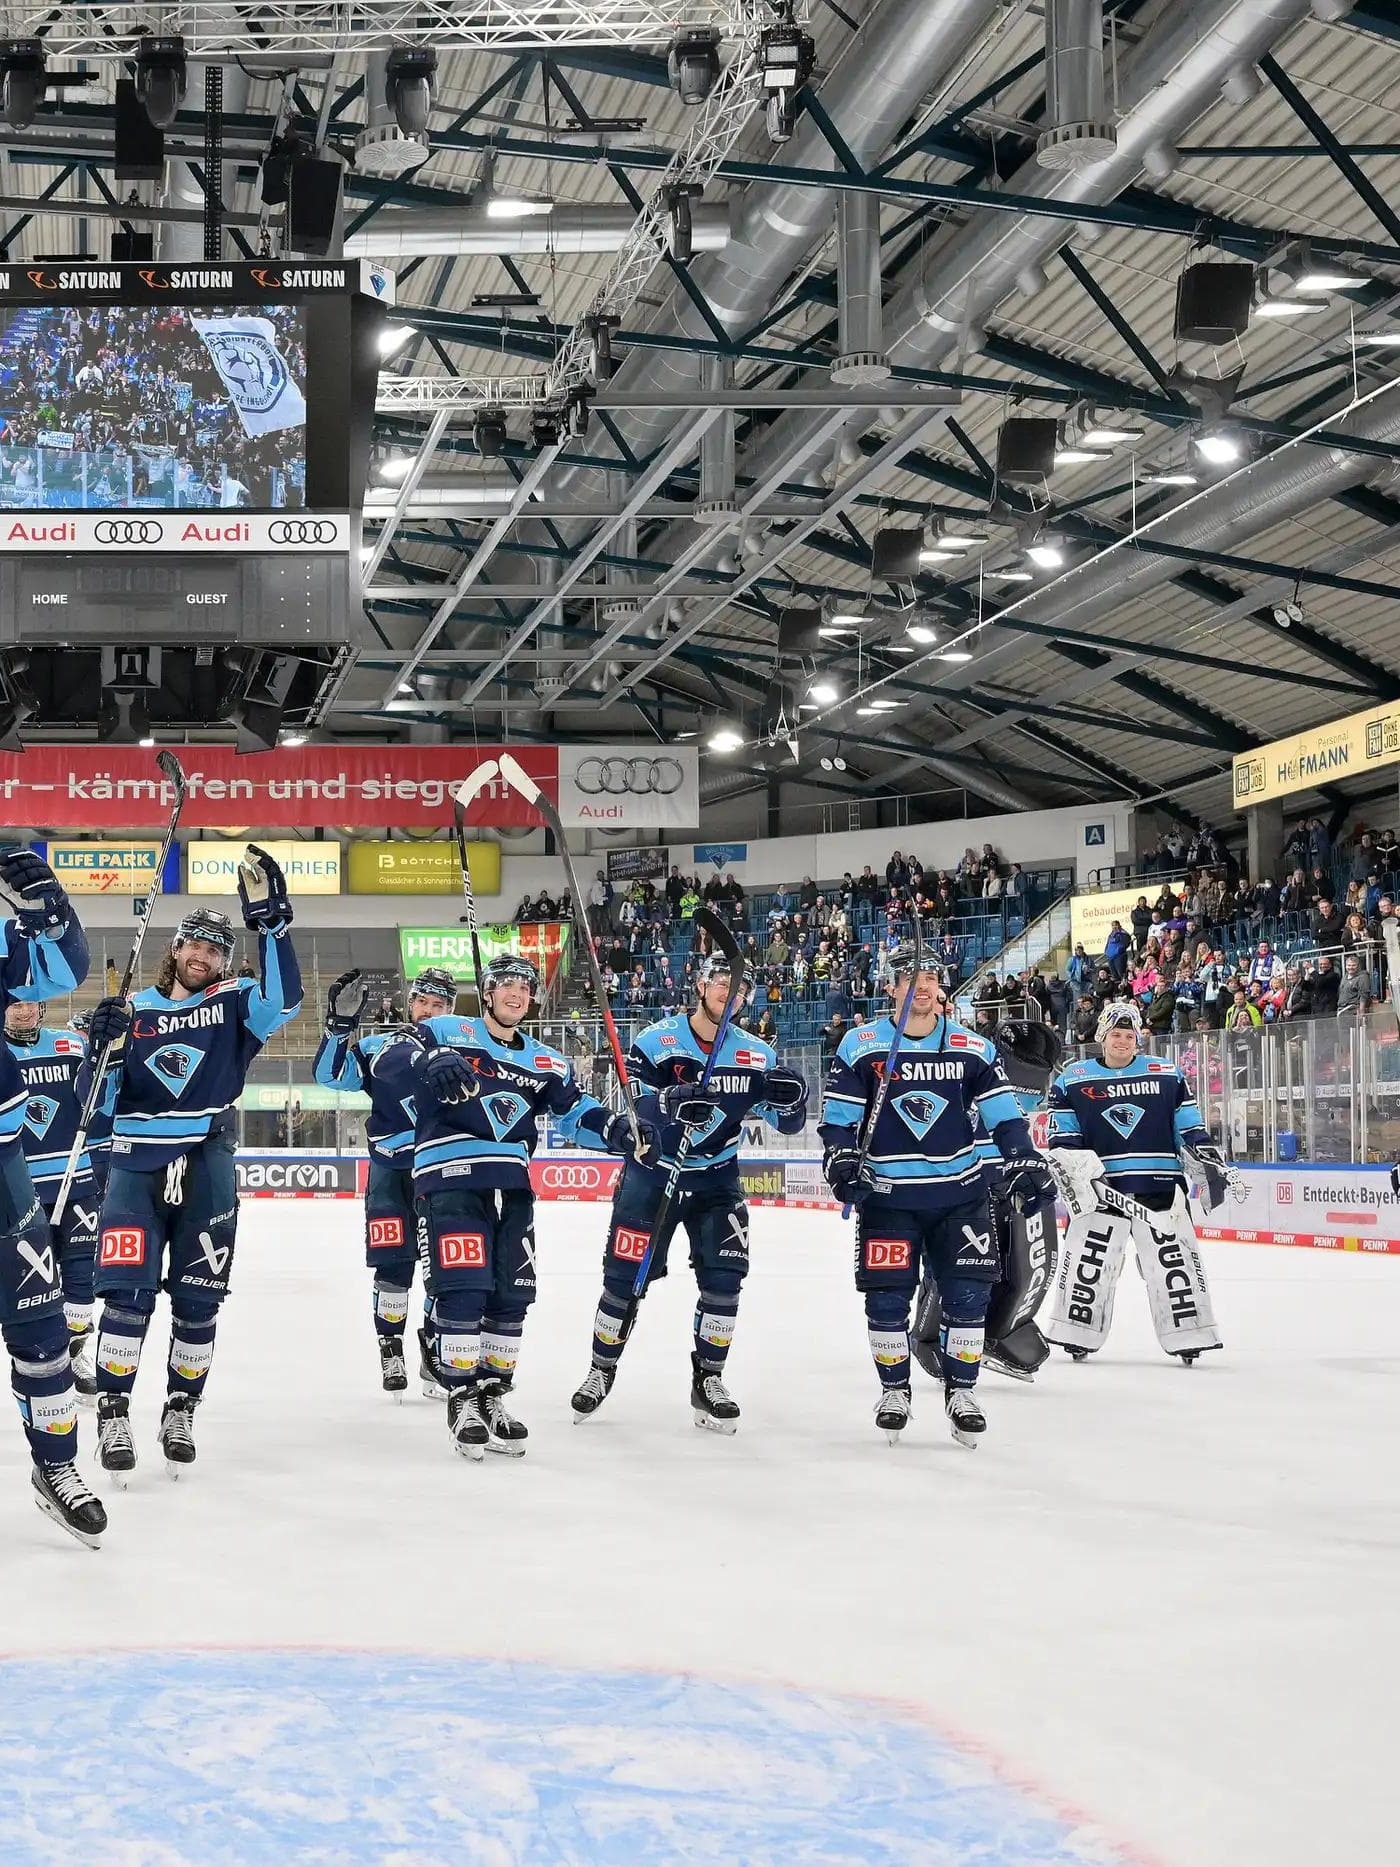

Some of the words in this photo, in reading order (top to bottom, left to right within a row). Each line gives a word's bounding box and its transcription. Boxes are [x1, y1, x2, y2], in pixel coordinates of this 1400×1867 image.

[58, 271, 122, 289] SATURN
[170, 270, 233, 289] SATURN
[282, 269, 345, 288] SATURN
[7, 522, 76, 541] Audi
[181, 522, 250, 542] Audi
[32, 594, 68, 605] HOME
[186, 594, 228, 605] GUEST
[1317, 730, 1349, 747] Personal
[1384, 732, 1398, 749] JOB
[68, 772, 255, 808] kämpfen
[268, 772, 345, 800] und
[1250, 775, 1263, 789] JOB
[577, 804, 624, 819] Audi
[1088, 827, 1102, 844] A
[58, 853, 97, 867] LIFE
[98, 852, 151, 867] PARK
[400, 857, 462, 866] BÖTTCHE
[157, 1002, 224, 1035] SATURN
[20, 1063, 70, 1085] SATURN
[1107, 1081, 1160, 1098] SATURN
[1278, 1185, 1292, 1201] DB
[1104, 1188, 1152, 1224] BÜCHL
[70, 1234, 99, 1244] BAUE
[371, 1224, 399, 1242] DB
[1202, 1228, 1222, 1238] PENNY.
[1236, 1231, 1258, 1241] PENNY.
[1273, 1234, 1296, 1244] PENNY.
[104, 1233, 139, 1260] DB
[443, 1238, 482, 1262] DB
[617, 1233, 649, 1258] DB
[1313, 1236, 1338, 1248] PENNY.
[1363, 1239, 1390, 1251] PENNY.
[870, 1245, 905, 1264] DB
[955, 1258, 996, 1266] BAUER
[1010, 1212, 1045, 1329] BÜCHL
[1058, 1249, 1072, 1291] BAUER
[1068, 1225, 1114, 1325] BÜCHL
[1150, 1226, 1198, 1328] BÜCHL
[1190, 1251, 1206, 1294] BAUER
[180, 1275, 226, 1290] BAUER
